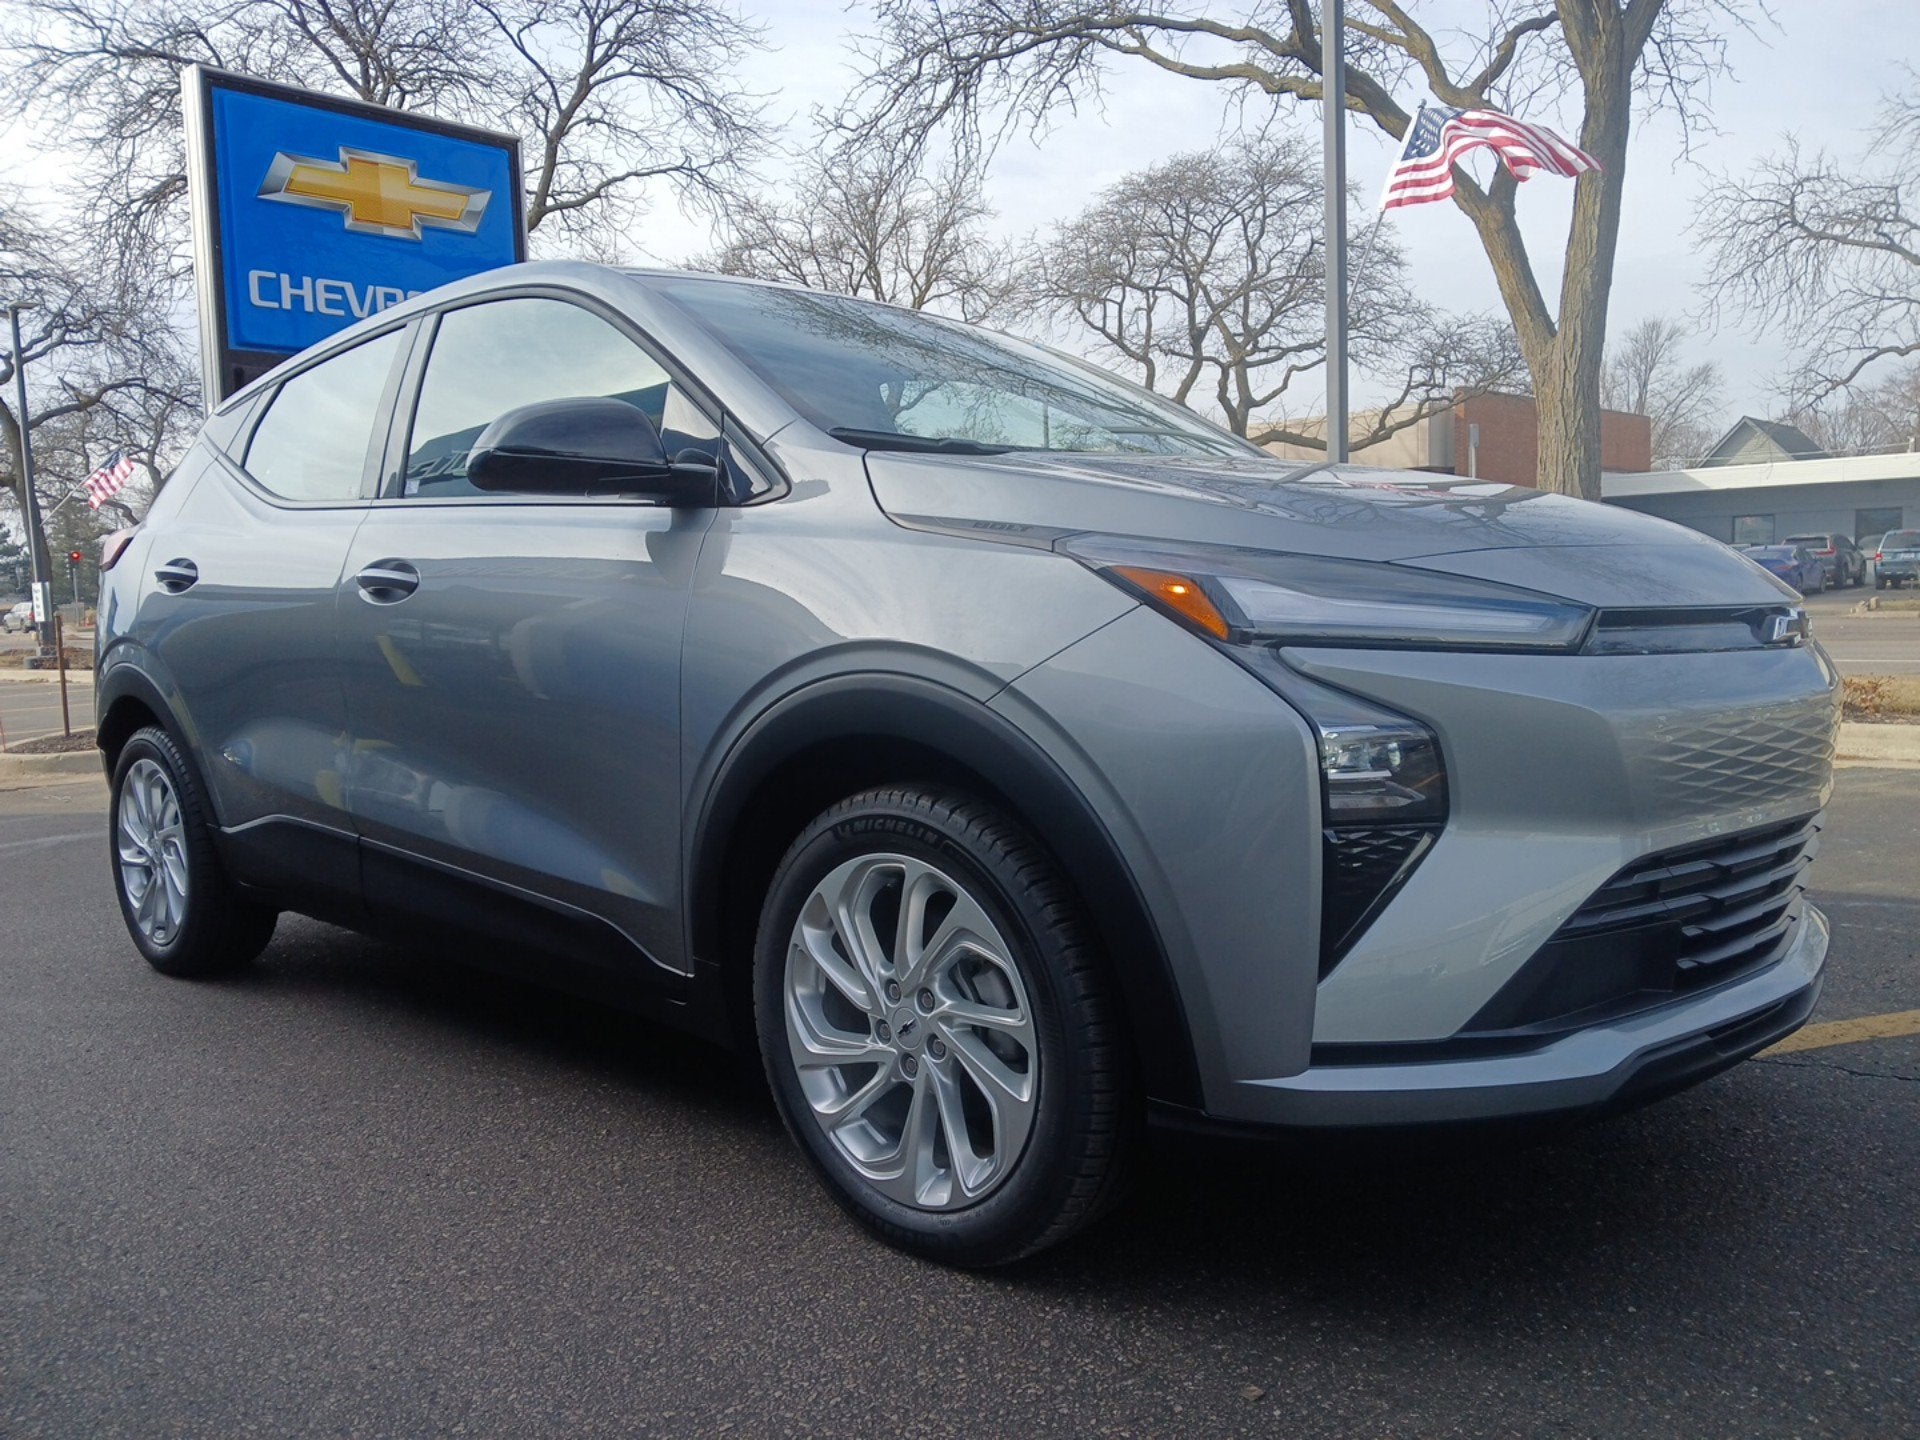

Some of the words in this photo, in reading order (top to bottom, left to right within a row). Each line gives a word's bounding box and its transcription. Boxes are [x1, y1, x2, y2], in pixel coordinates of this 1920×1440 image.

[248, 269, 424, 318] CHEVR
[973, 521, 1031, 532] BOLT
[853, 819, 939, 844] MICHELIN
